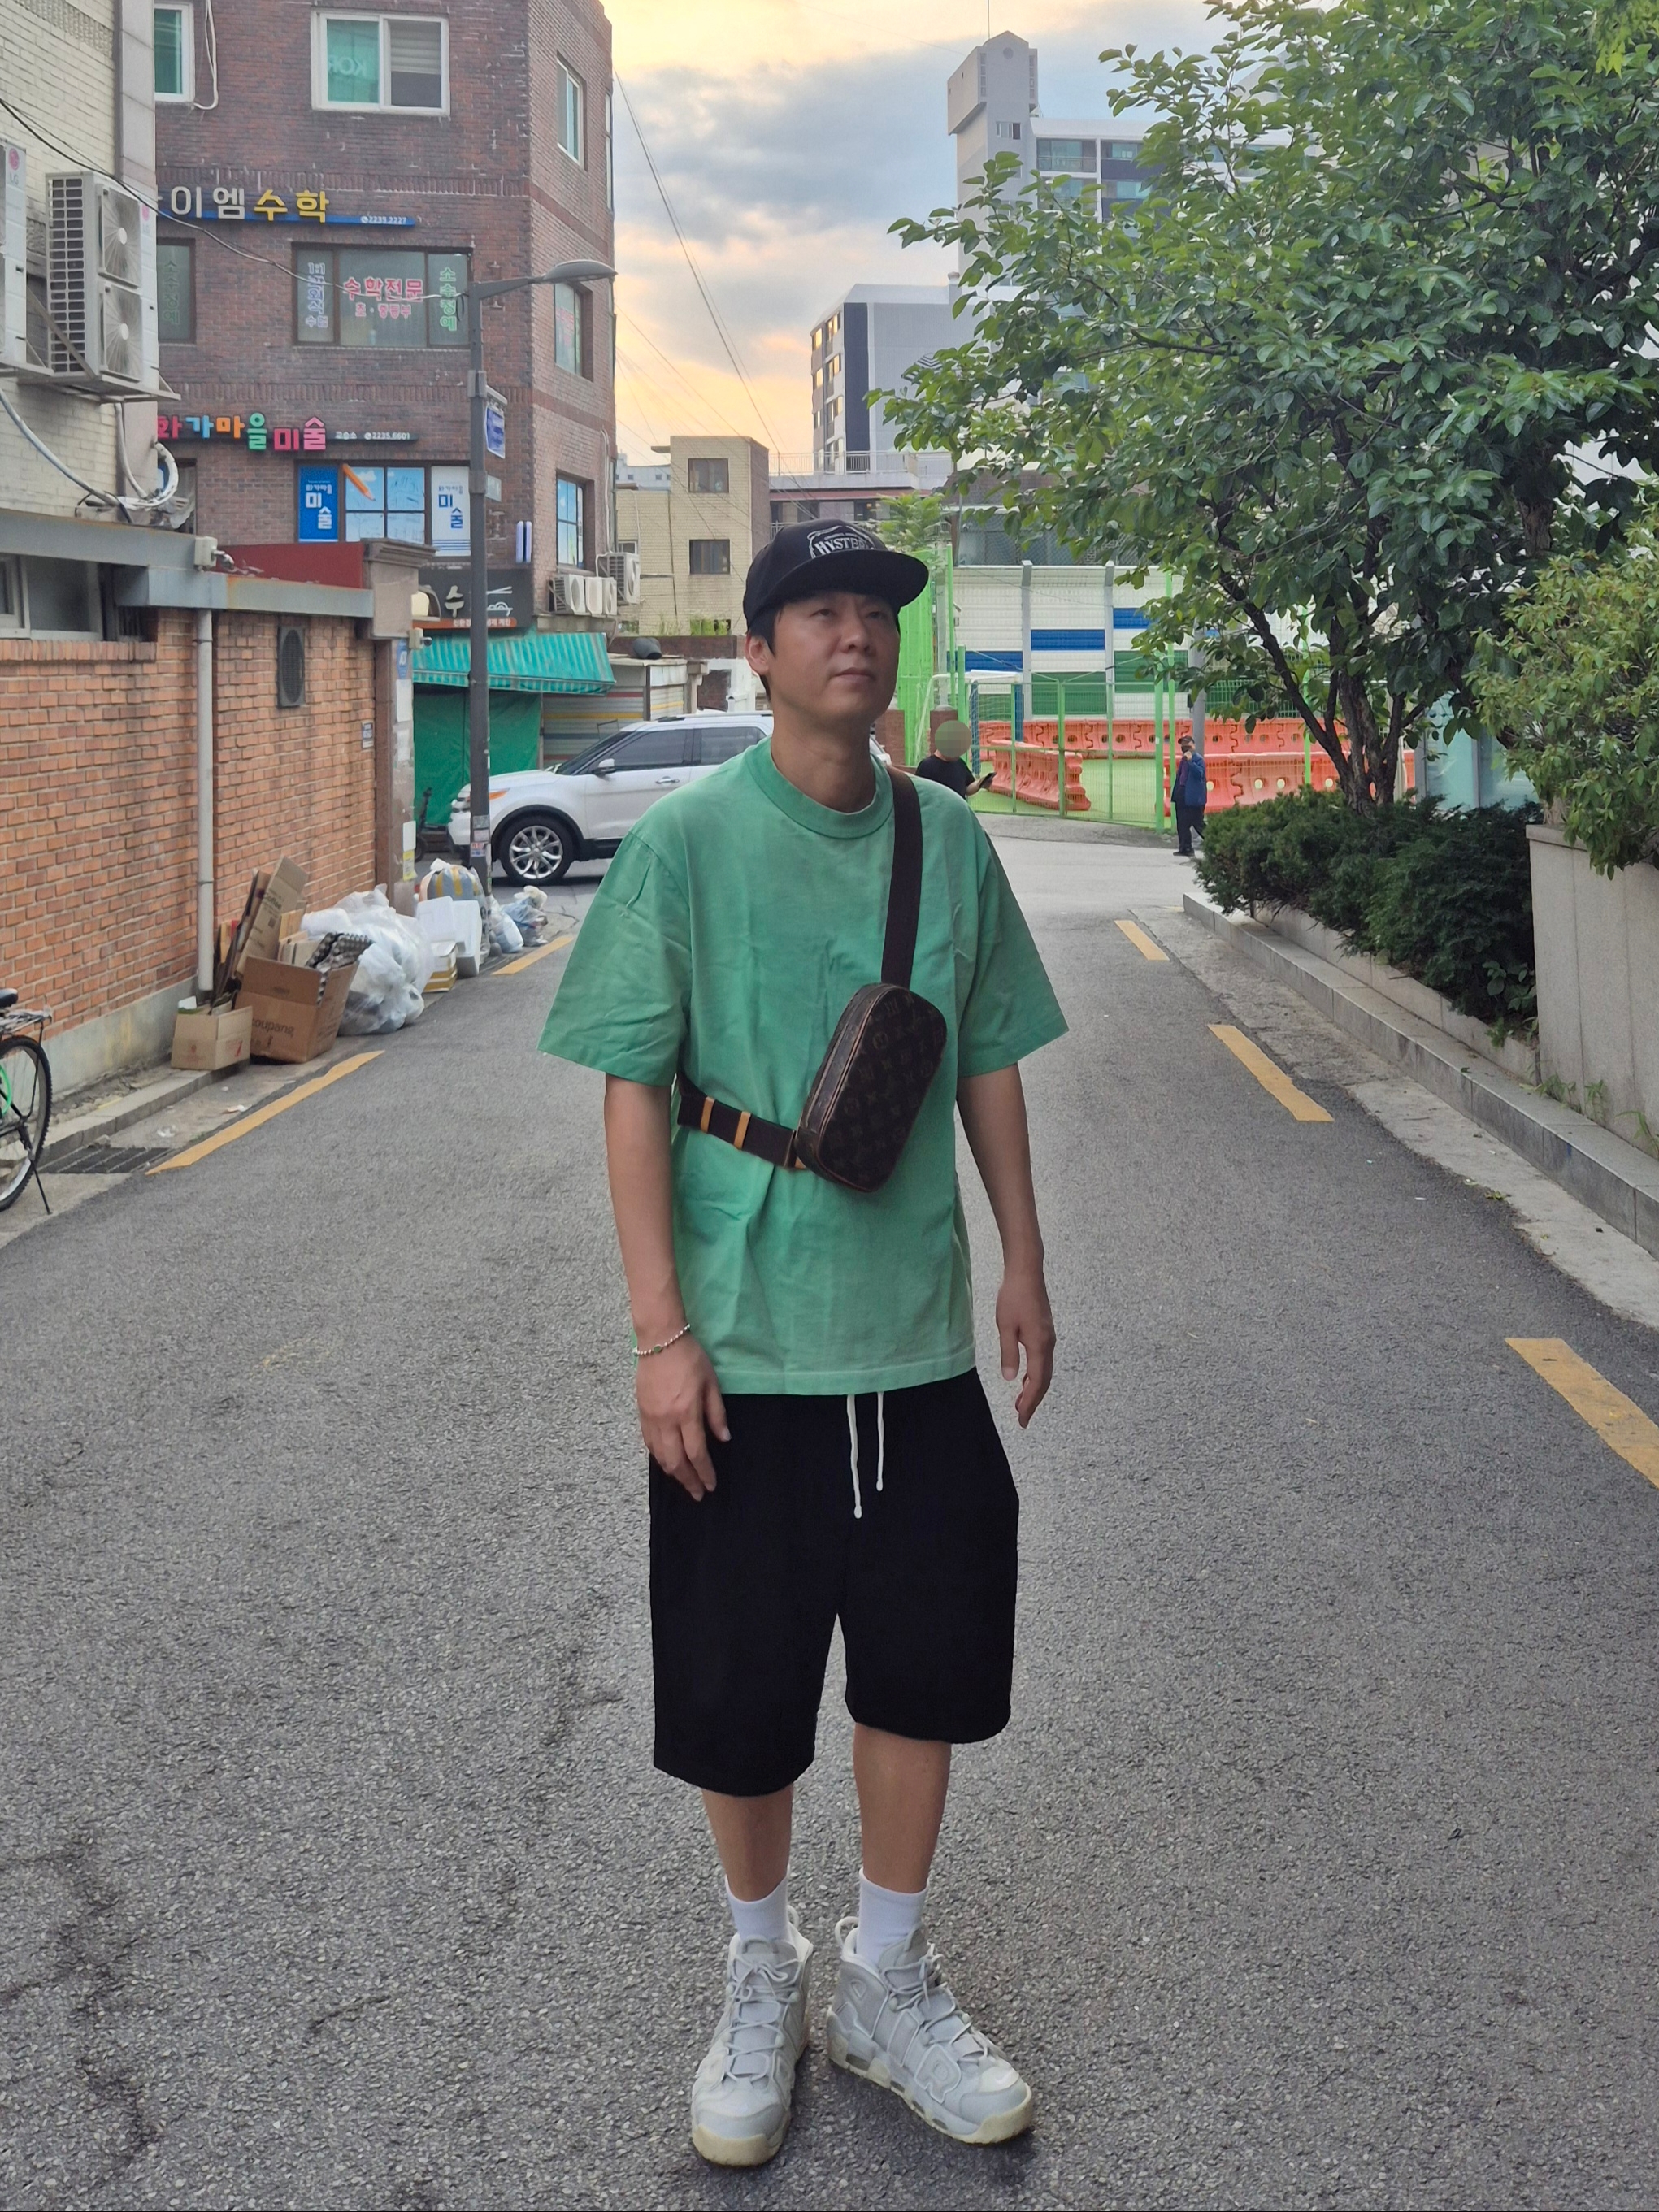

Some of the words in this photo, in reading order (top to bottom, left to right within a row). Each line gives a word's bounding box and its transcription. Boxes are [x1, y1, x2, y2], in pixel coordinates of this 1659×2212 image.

[10, 173, 19, 185] LG
[342, 276, 423, 302] 수학전문
[440, 267, 457, 332] 소수정예
